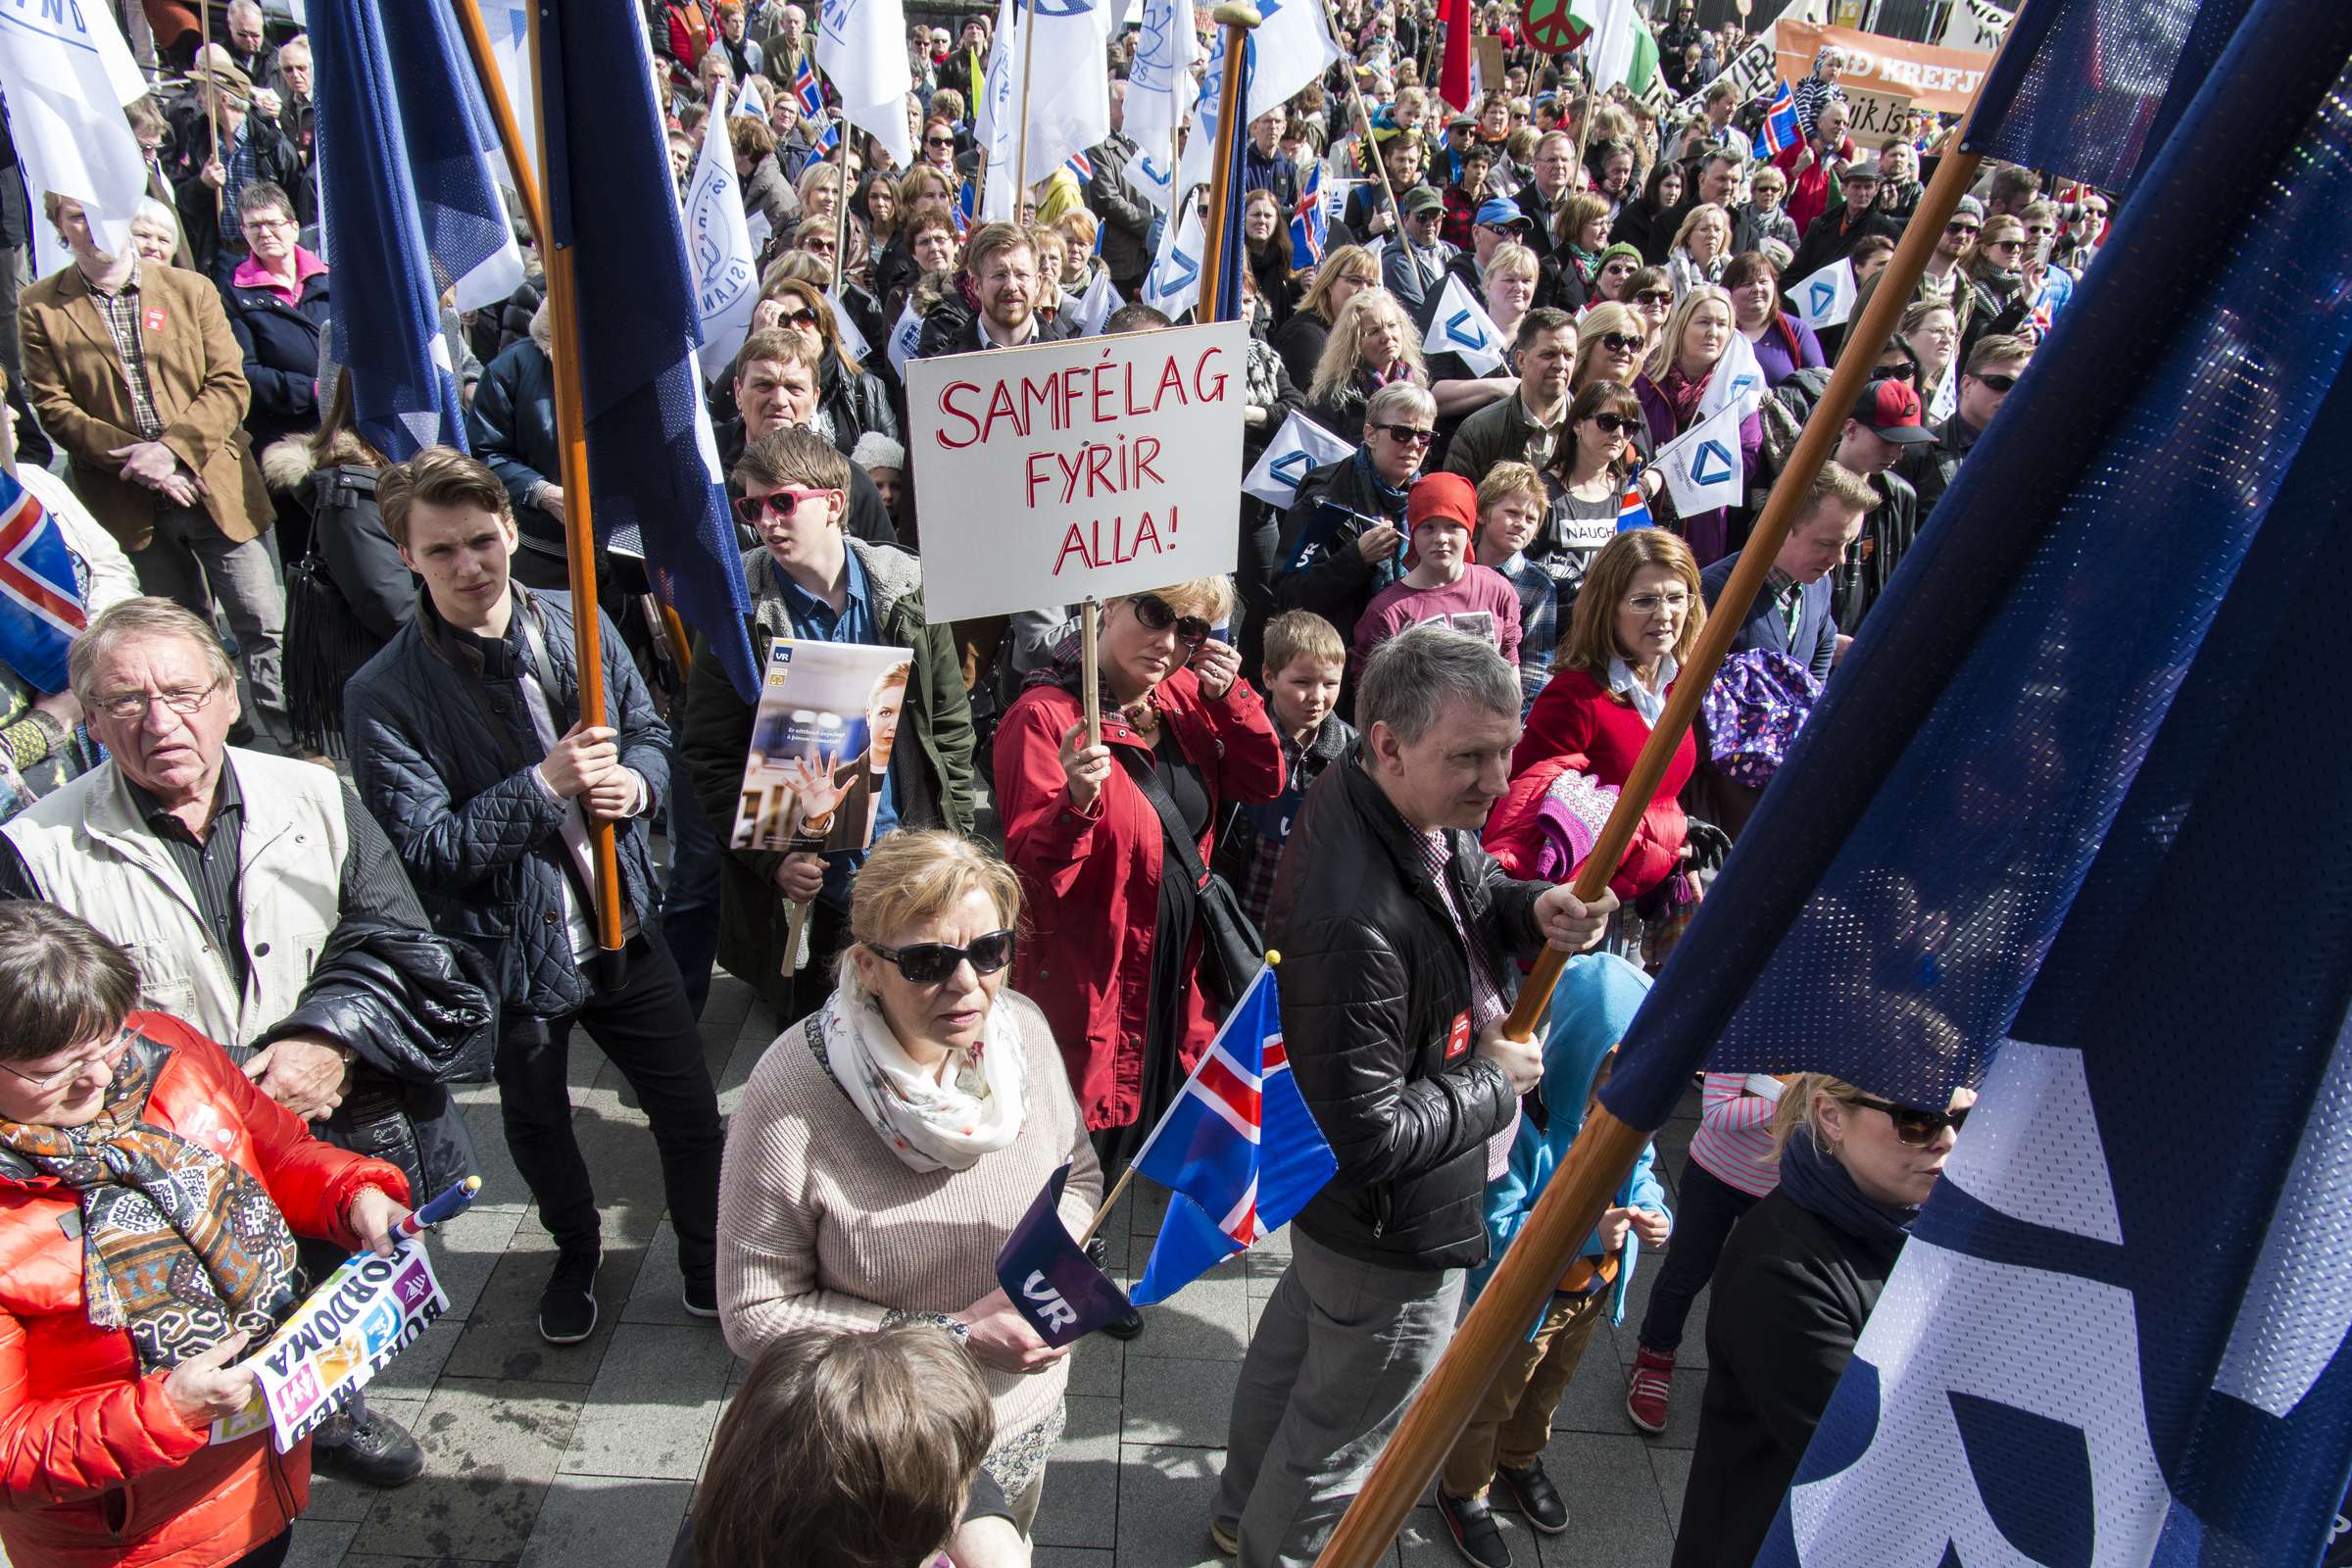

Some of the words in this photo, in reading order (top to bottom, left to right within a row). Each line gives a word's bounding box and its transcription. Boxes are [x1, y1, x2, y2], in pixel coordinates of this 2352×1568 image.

[1878, 57, 1986, 93] KREFJ
[936, 347, 1228, 450] SAMFÉLAG
[1052, 506, 1178, 576] ALLA!
[776, 652, 789, 662] VR
[1023, 1269, 1078, 1334] VR
